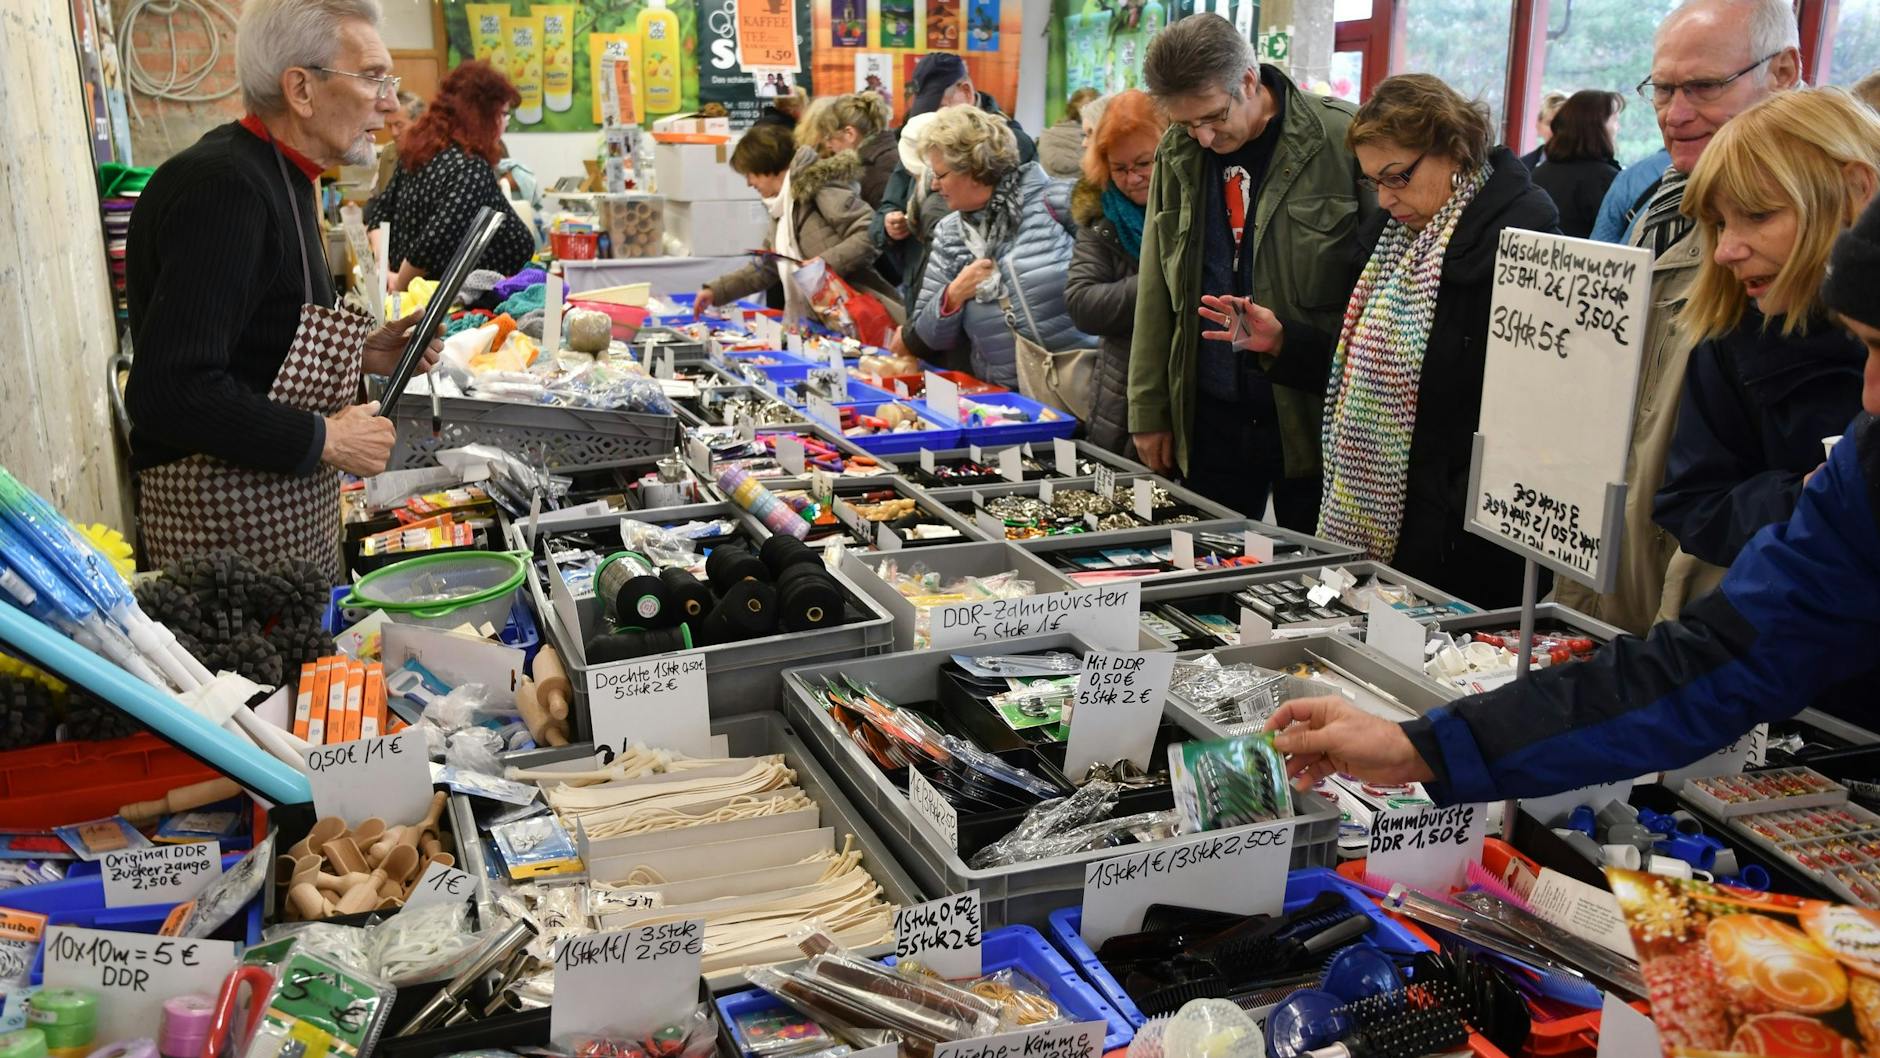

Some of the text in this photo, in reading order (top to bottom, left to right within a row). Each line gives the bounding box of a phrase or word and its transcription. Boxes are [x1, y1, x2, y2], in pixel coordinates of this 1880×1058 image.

[744, 16, 789, 28] KAFFEE
[743, 31, 767, 42] TEE
[765, 49, 792, 61] 1,50
[1500, 231, 1637, 285] Wäscheklammern
[1575, 299, 1629, 346] 3,50€
[943, 587, 1130, 629] DDR-Zahnbürsten
[1086, 653, 1146, 672] Mit DDR
[595, 664, 651, 690] Dochte
[1090, 671, 1137, 690] 0,50€
[1370, 822, 1471, 854] DDR 1,50€
[105, 844, 208, 870] Original DDR
[131, 875, 182, 891] 2,50€
[427, 868, 468, 896] 1€
[635, 937, 702, 961] 2,50€
[102, 965, 151, 993] DDR
